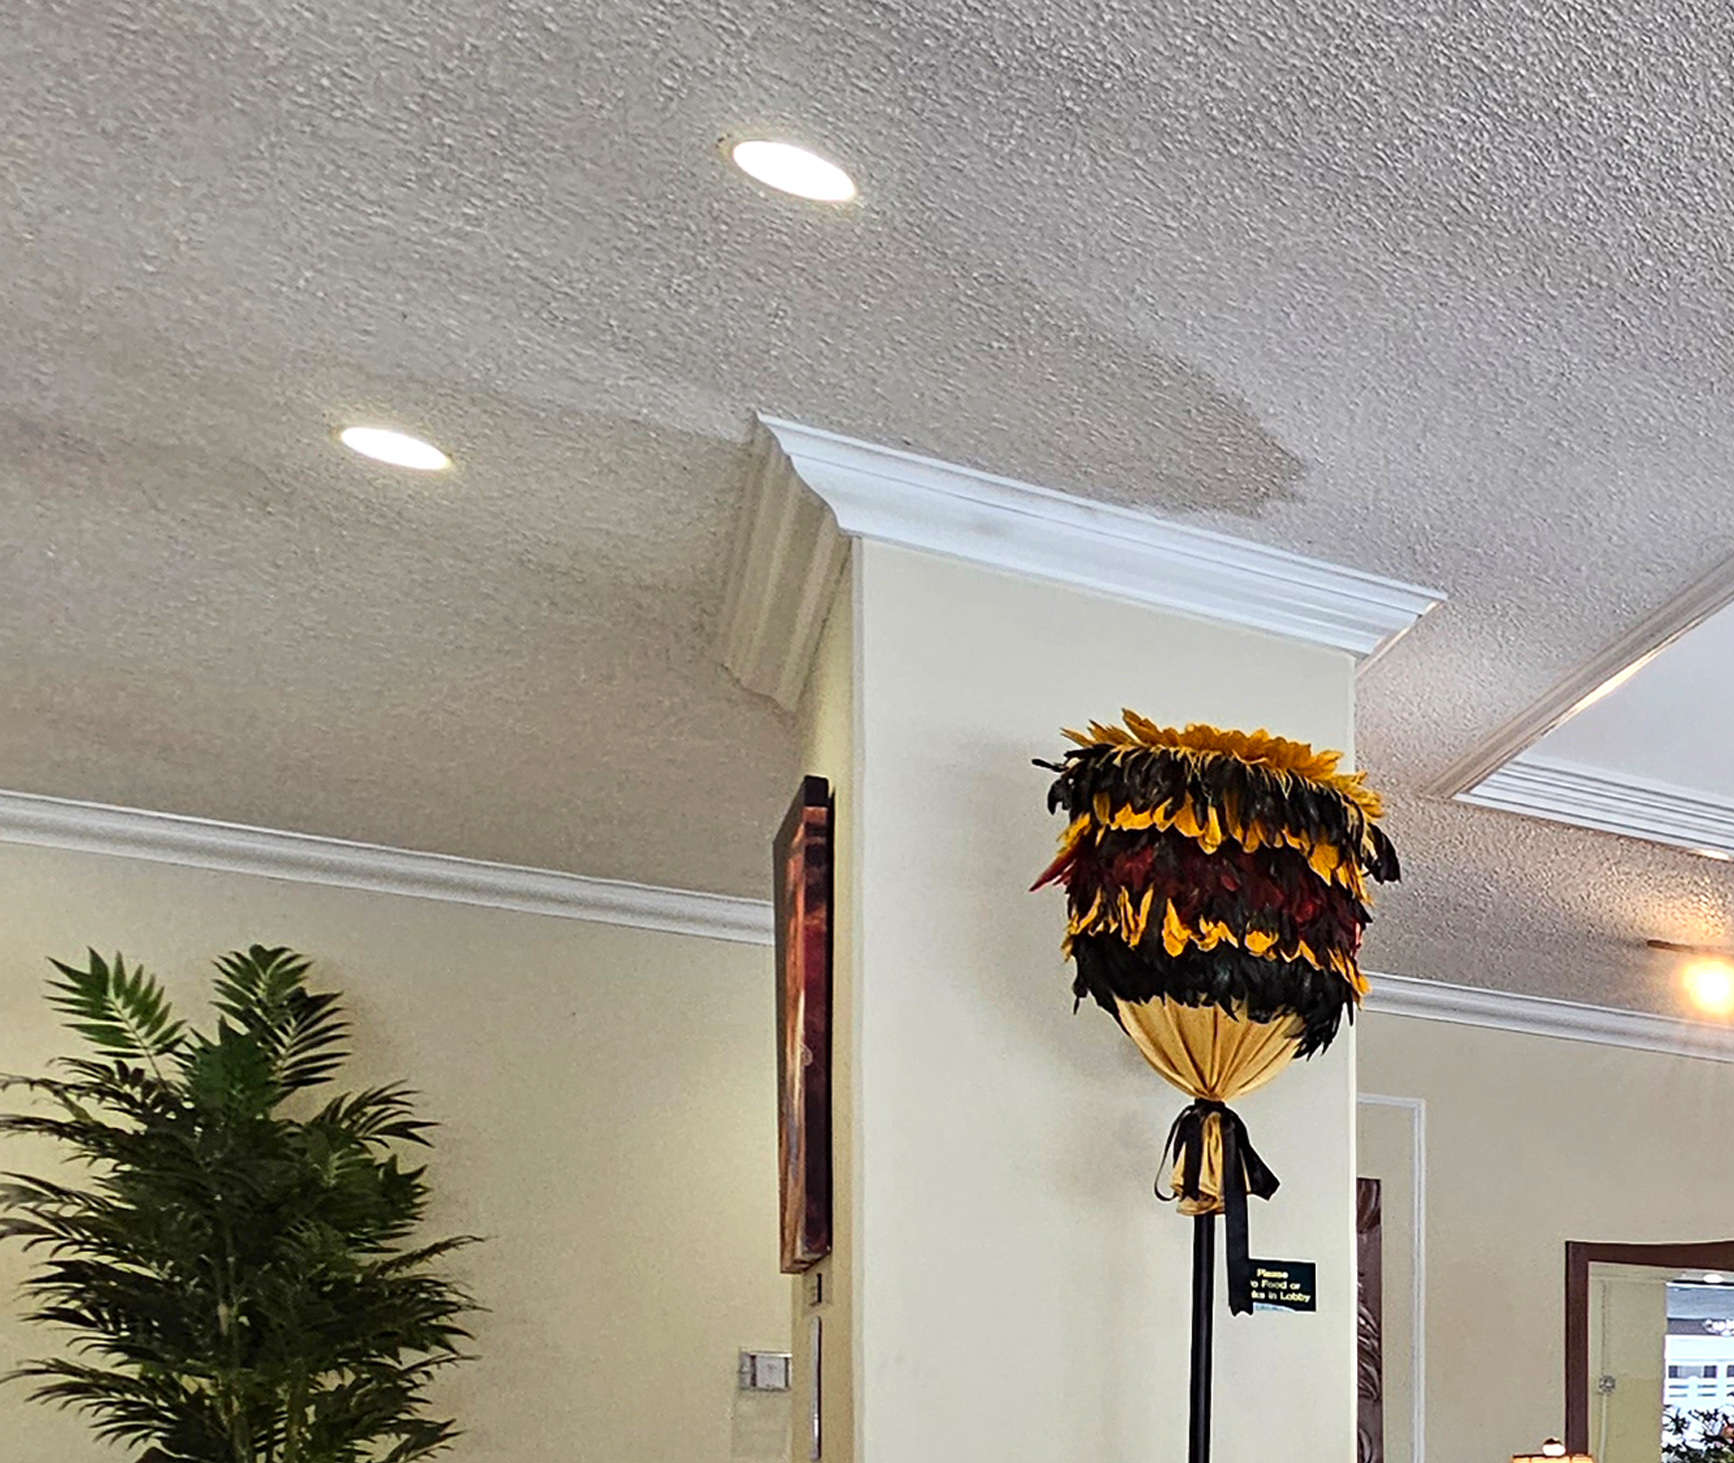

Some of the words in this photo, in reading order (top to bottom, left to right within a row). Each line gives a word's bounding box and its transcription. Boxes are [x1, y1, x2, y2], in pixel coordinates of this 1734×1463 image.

[1261, 1279, 1287, 1289] Food
[1268, 1291, 1277, 1300] in
[1280, 1291, 1311, 1303] Lobby
